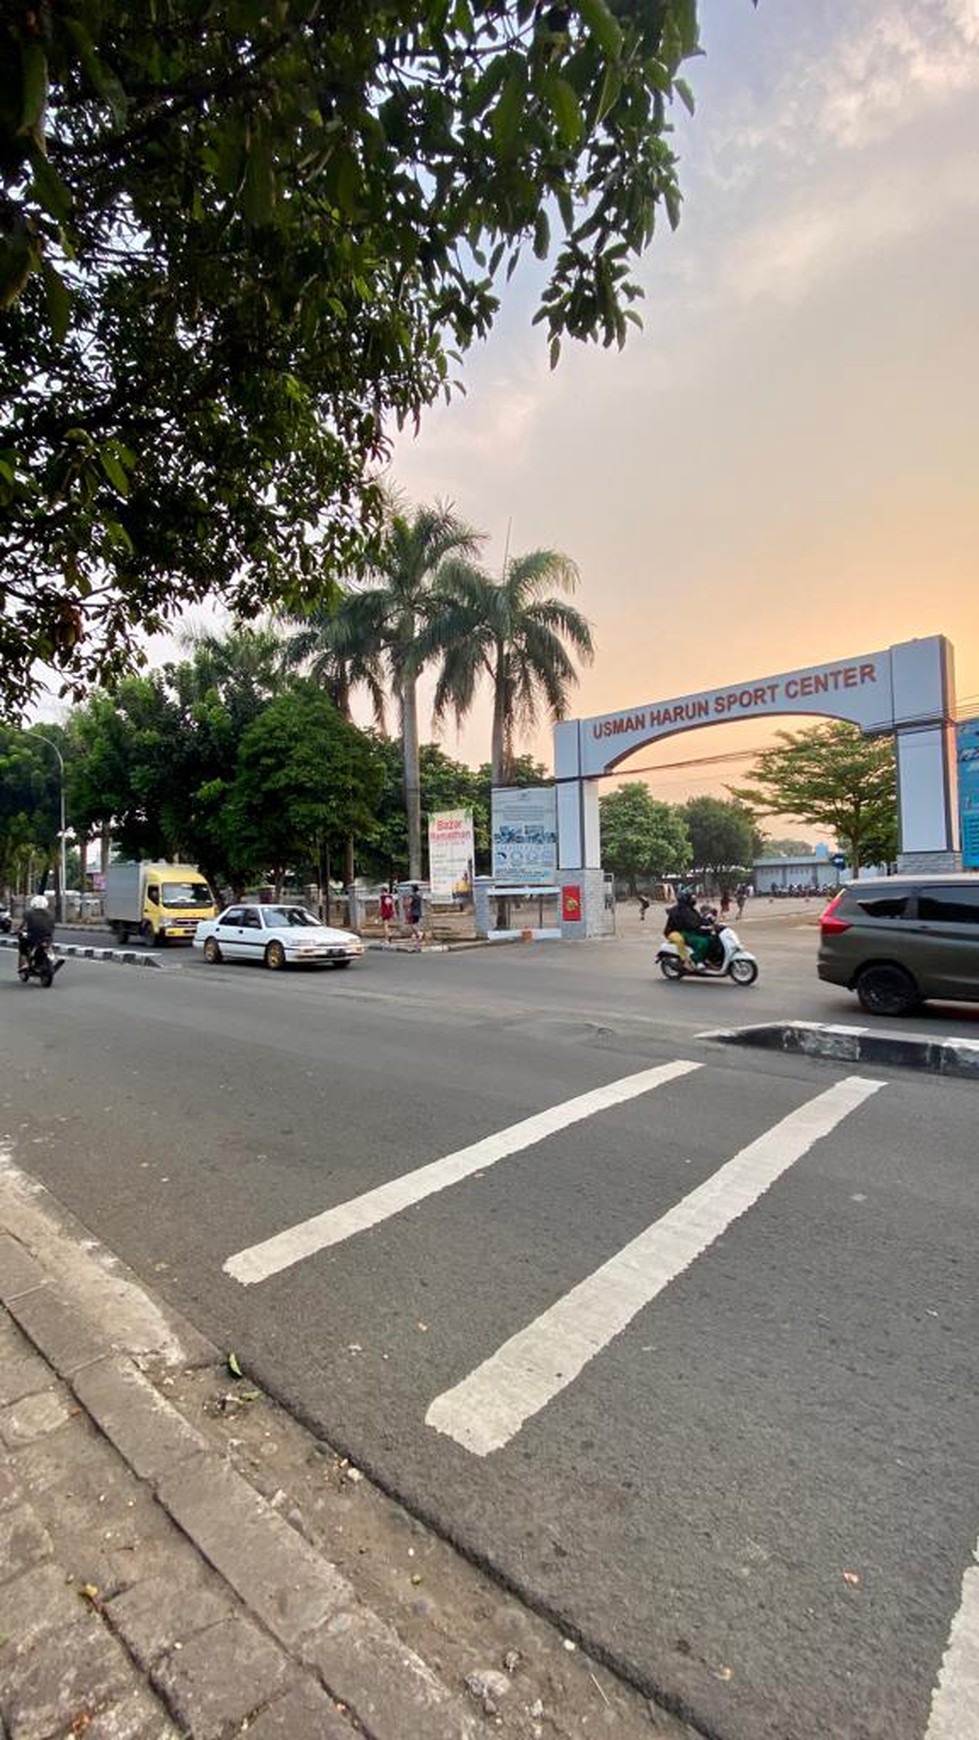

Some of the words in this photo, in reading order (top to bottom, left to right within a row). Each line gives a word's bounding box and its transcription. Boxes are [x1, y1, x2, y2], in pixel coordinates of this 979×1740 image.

[593, 714, 645, 739] USMAN
[650, 699, 709, 728] HARUN
[714, 684, 778, 713] SPORT
[785, 663, 876, 699] CENTER
